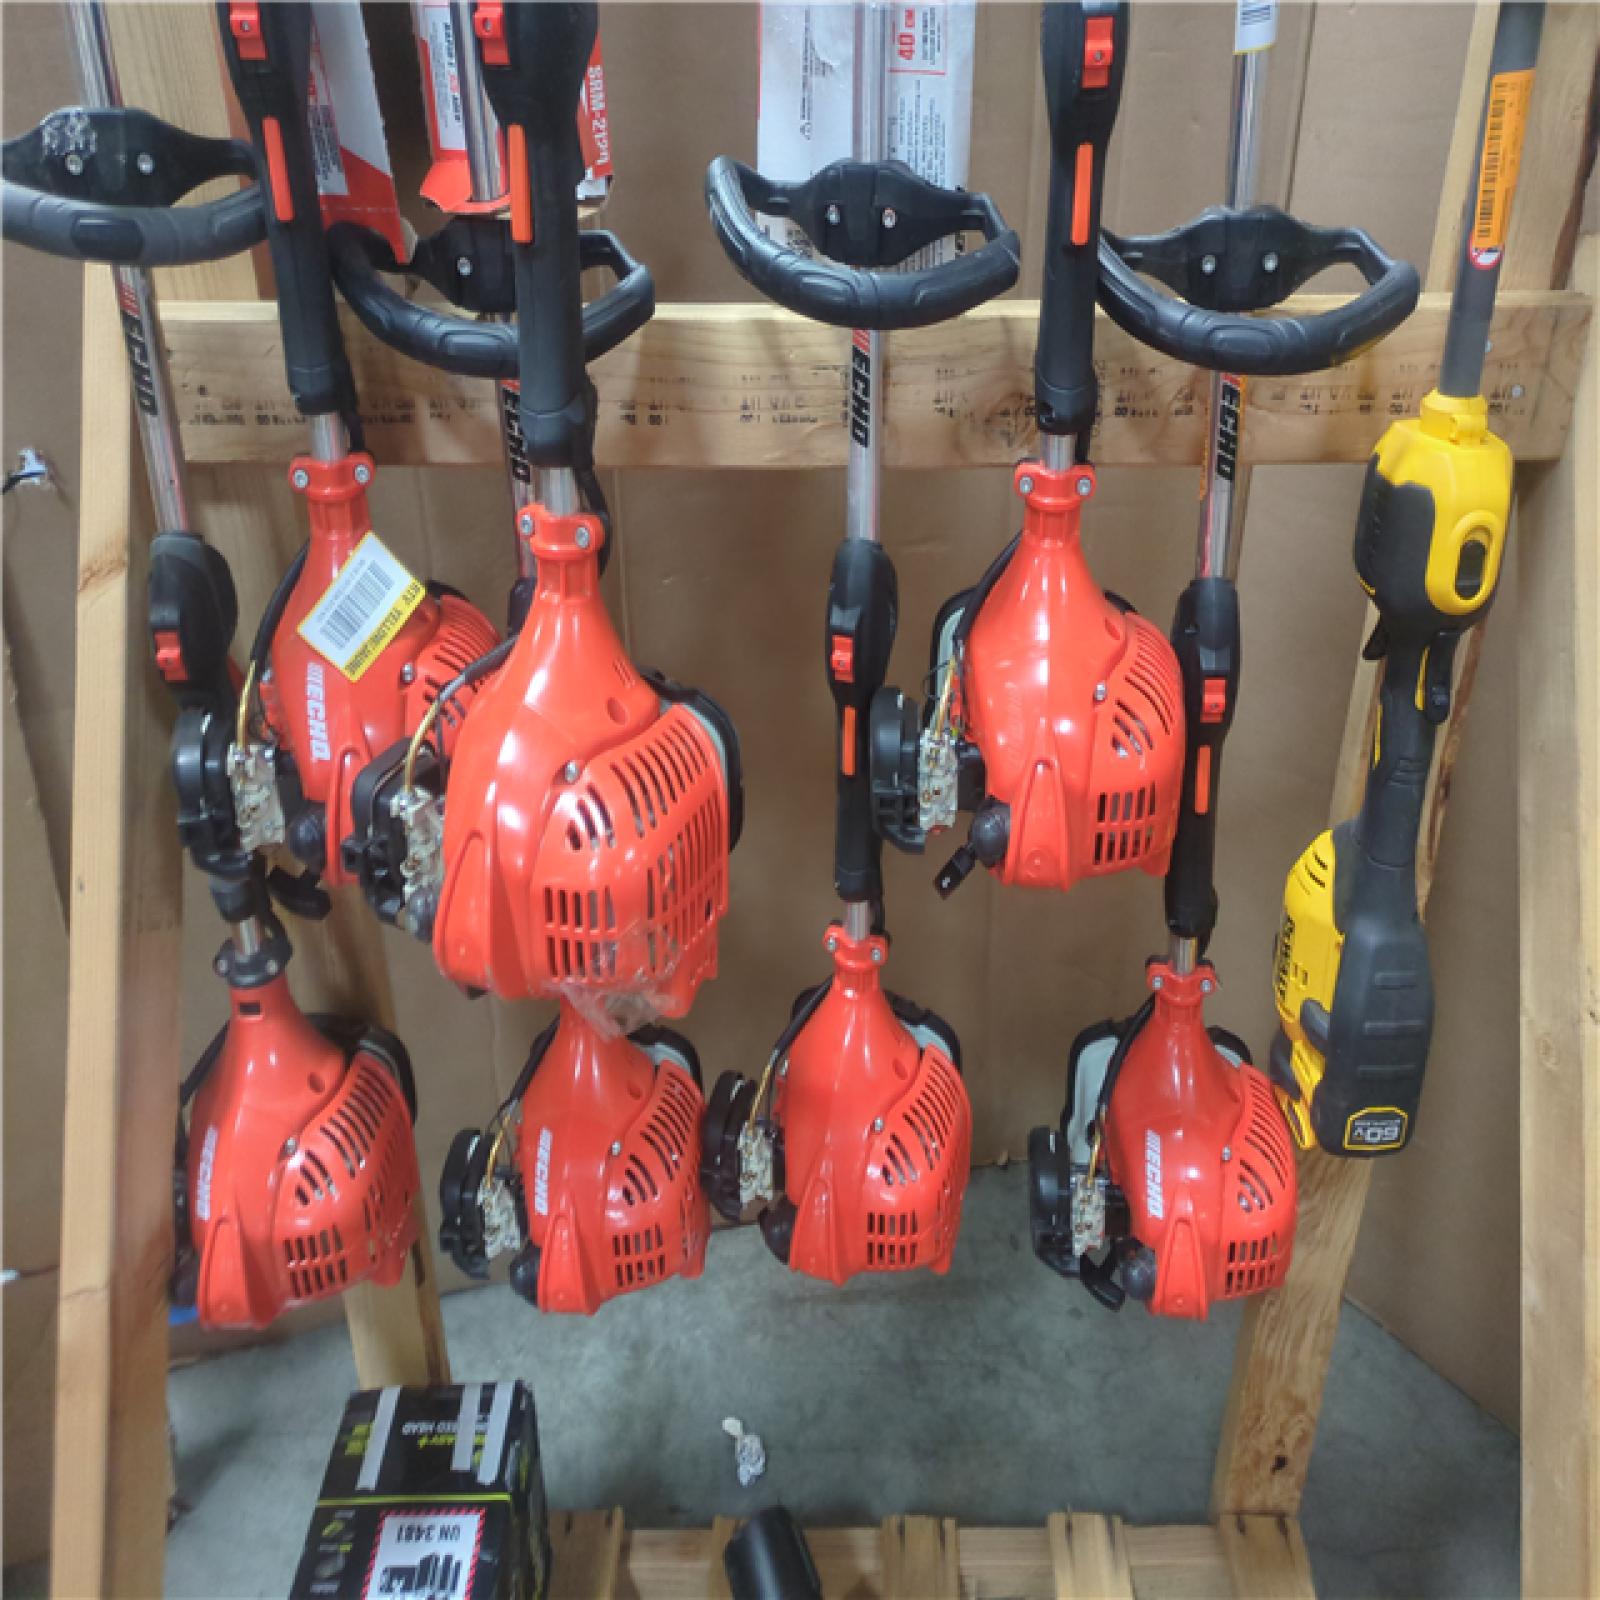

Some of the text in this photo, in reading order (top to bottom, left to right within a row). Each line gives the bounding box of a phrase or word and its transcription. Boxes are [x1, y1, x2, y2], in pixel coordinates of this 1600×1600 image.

[121, 309, 158, 416] ECHO
[852, 344, 871, 448] ECHO
[502, 387, 531, 483] ECHO
[1216, 382, 1241, 481] ECHO
[306, 683, 331, 762] ECHO
[534, 1148, 550, 1216] ECHO
[1145, 1151, 1163, 1220] ECHO
